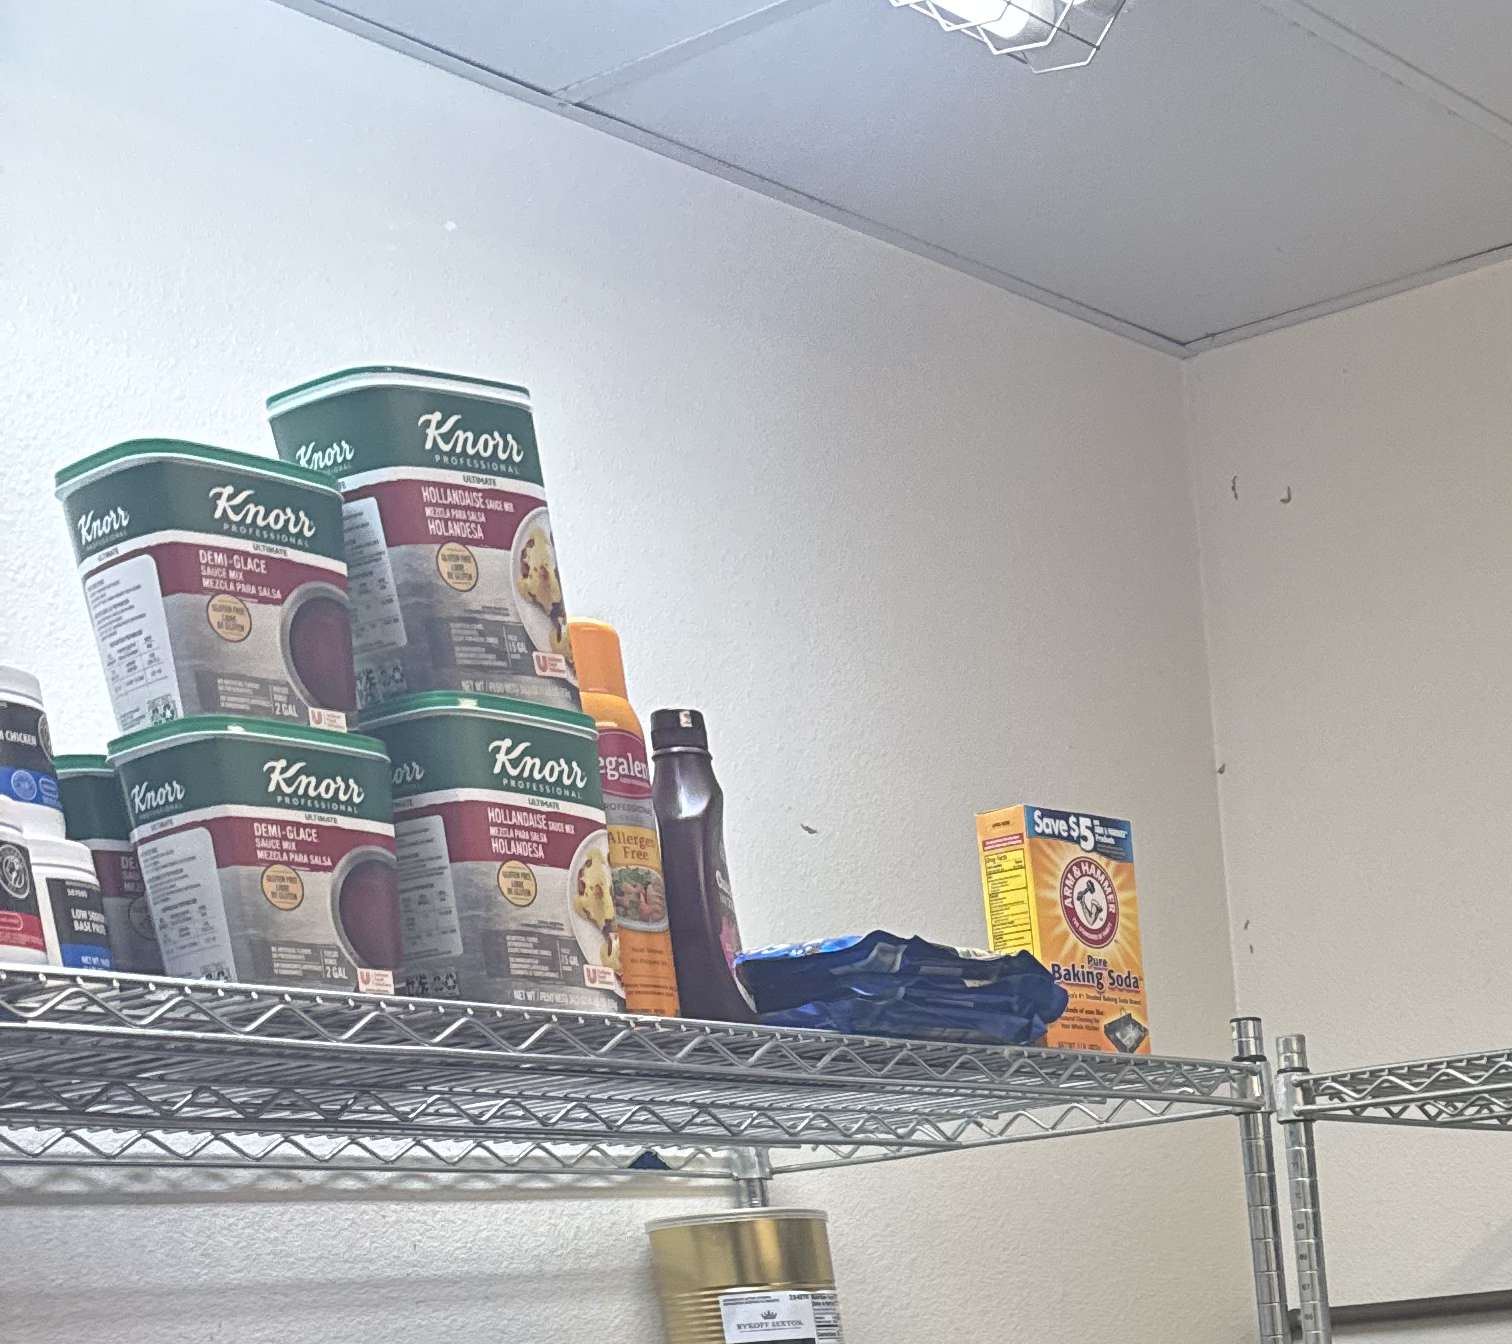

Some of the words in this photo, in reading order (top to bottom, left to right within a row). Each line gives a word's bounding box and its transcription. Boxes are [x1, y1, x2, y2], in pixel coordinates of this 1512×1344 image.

[418, 411, 524, 463] Knorr
[296, 440, 355, 470] Knorr
[434, 454, 521, 475] PROFESSIONAL
[421, 487, 485, 508] HOLLANDAISE
[208, 484, 316, 537] Knorr
[78, 507, 130, 545] Knorr
[223, 523, 310, 547] PROFESSIONAL
[427, 519, 484, 539] HOLANDESA
[198, 550, 267, 574] DEMI-GLACE
[200, 566, 227, 579] SAUCE
[229, 568, 244, 580] MIX
[202, 578, 236, 592] MEZCLA
[258, 587, 282, 599] SALSA
[488, 738, 587, 788] Knorr
[263, 758, 364, 804] Knorr
[502, 778, 583, 799] PROFESSIONAL
[131, 780, 185, 813] Knorr
[277, 796, 358, 814] PROFESSIONAL
[487, 808, 546, 831] HOLLANDAISE
[1034, 809, 1070, 837] Save
[254, 822, 319, 842] DEMI-GLACE
[255, 838, 281, 850] SAUCE
[283, 840, 296, 851] MIX
[491, 839, 544, 859] HOLANDESA
[623, 847, 649, 861] Free
[257, 849, 288, 862] MEZCLA
[289, 853, 308, 864] PARA
[310, 855, 332, 866] SALSA
[1081, 859, 1117, 913] HAMMER
[1086, 954, 1108, 969] Pure
[1051, 963, 1105, 990] Baking
[1108, 969, 1140, 990] Soda
